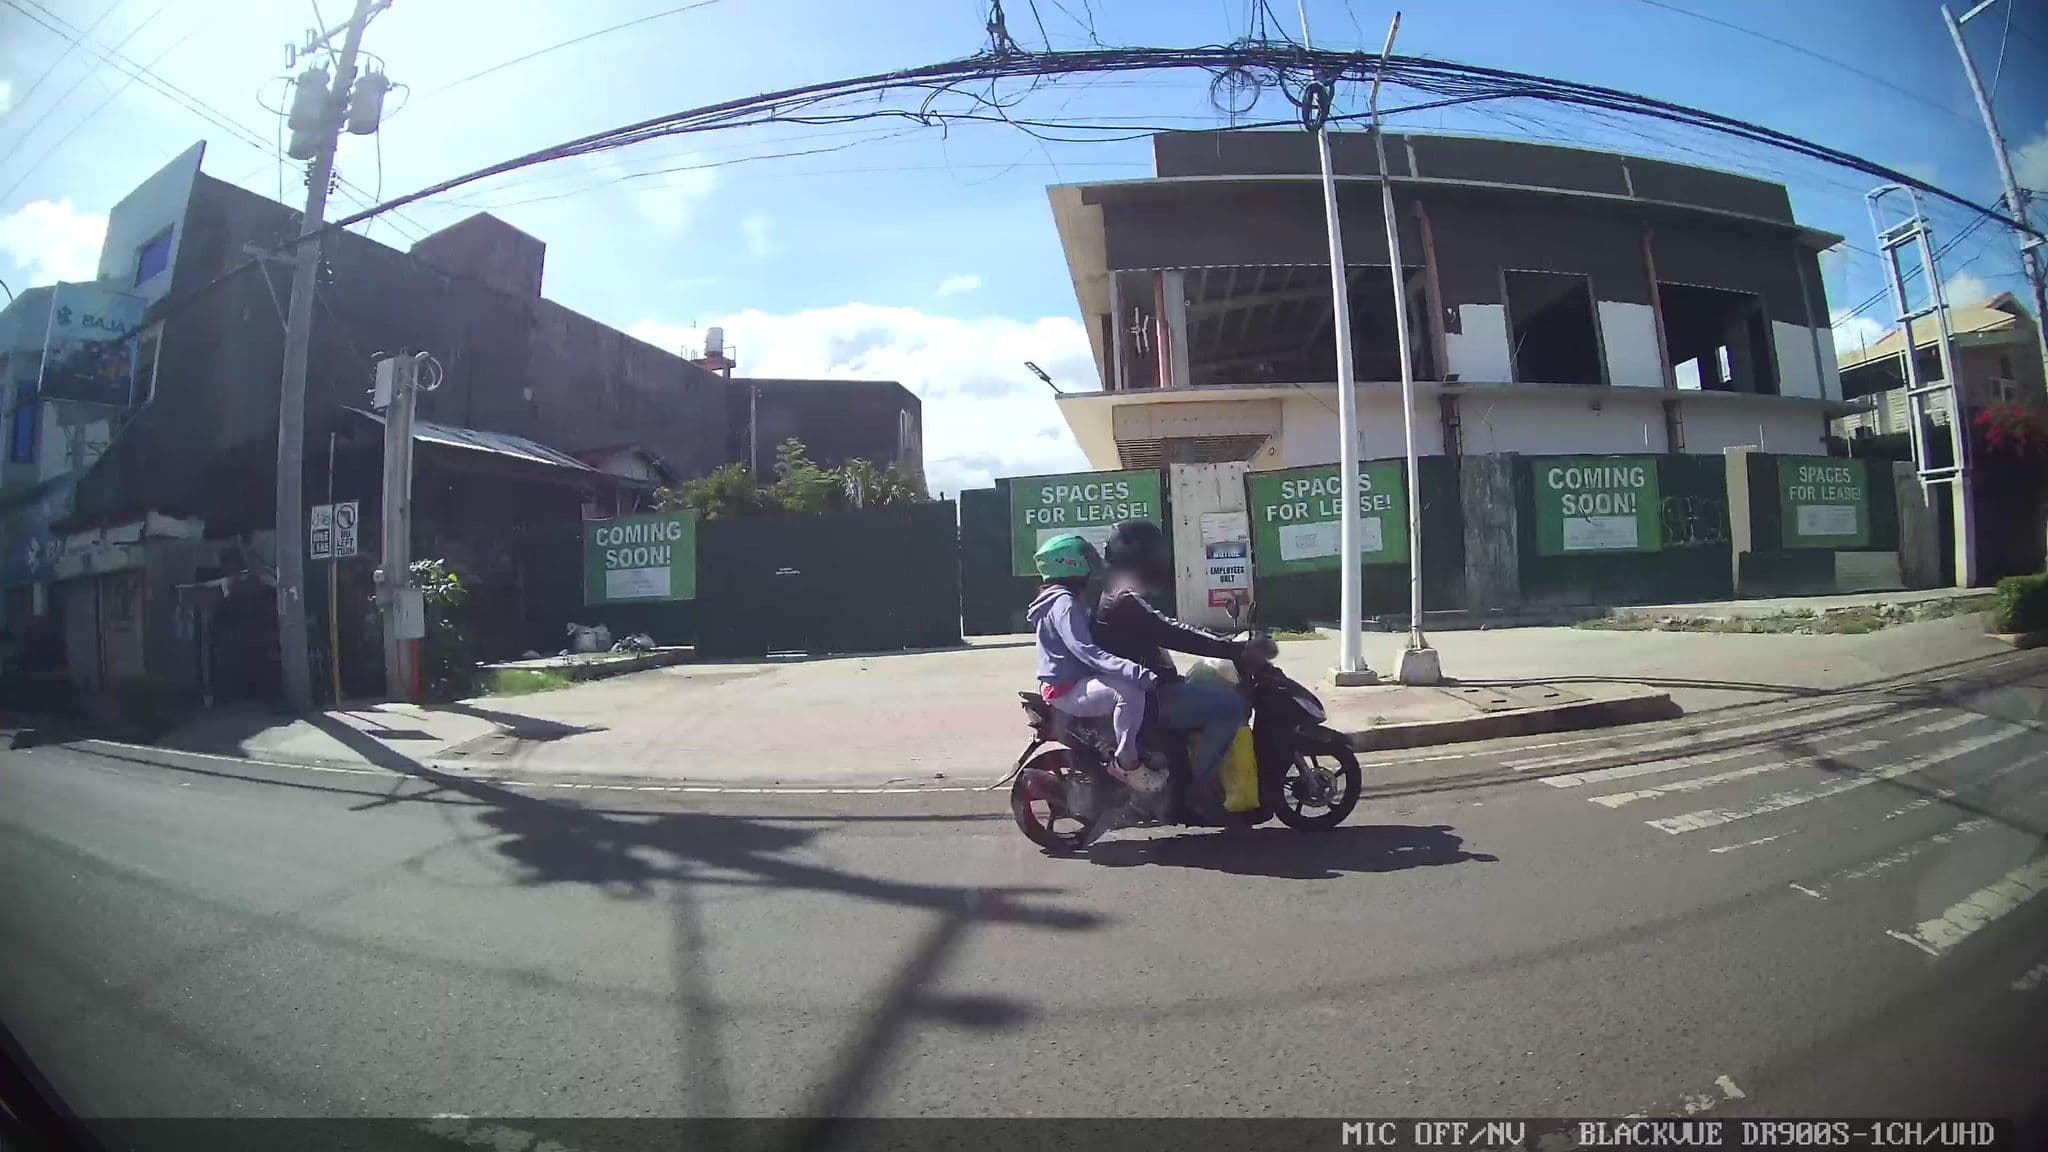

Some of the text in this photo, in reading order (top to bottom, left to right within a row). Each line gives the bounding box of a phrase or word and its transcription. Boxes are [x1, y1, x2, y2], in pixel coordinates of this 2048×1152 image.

[1548, 467, 1645, 489] COMING
[1798, 466, 1851, 483] SPACES
[1041, 481, 1129, 504] SPACES
[1281, 473, 1372, 499] SPACS
[1789, 486, 1816, 500] FOR
[1025, 502, 1149, 524] FOR LEASE!
[1266, 493, 1392, 522] FOR LESE!
[1561, 492, 1637, 515] SOON!
[595, 520, 682, 546] COMING
[605, 545, 671, 569] SOON!
[1210, 565, 1245, 575] EMPLOYEES
[1219, 574, 1235, 583] ONLY
